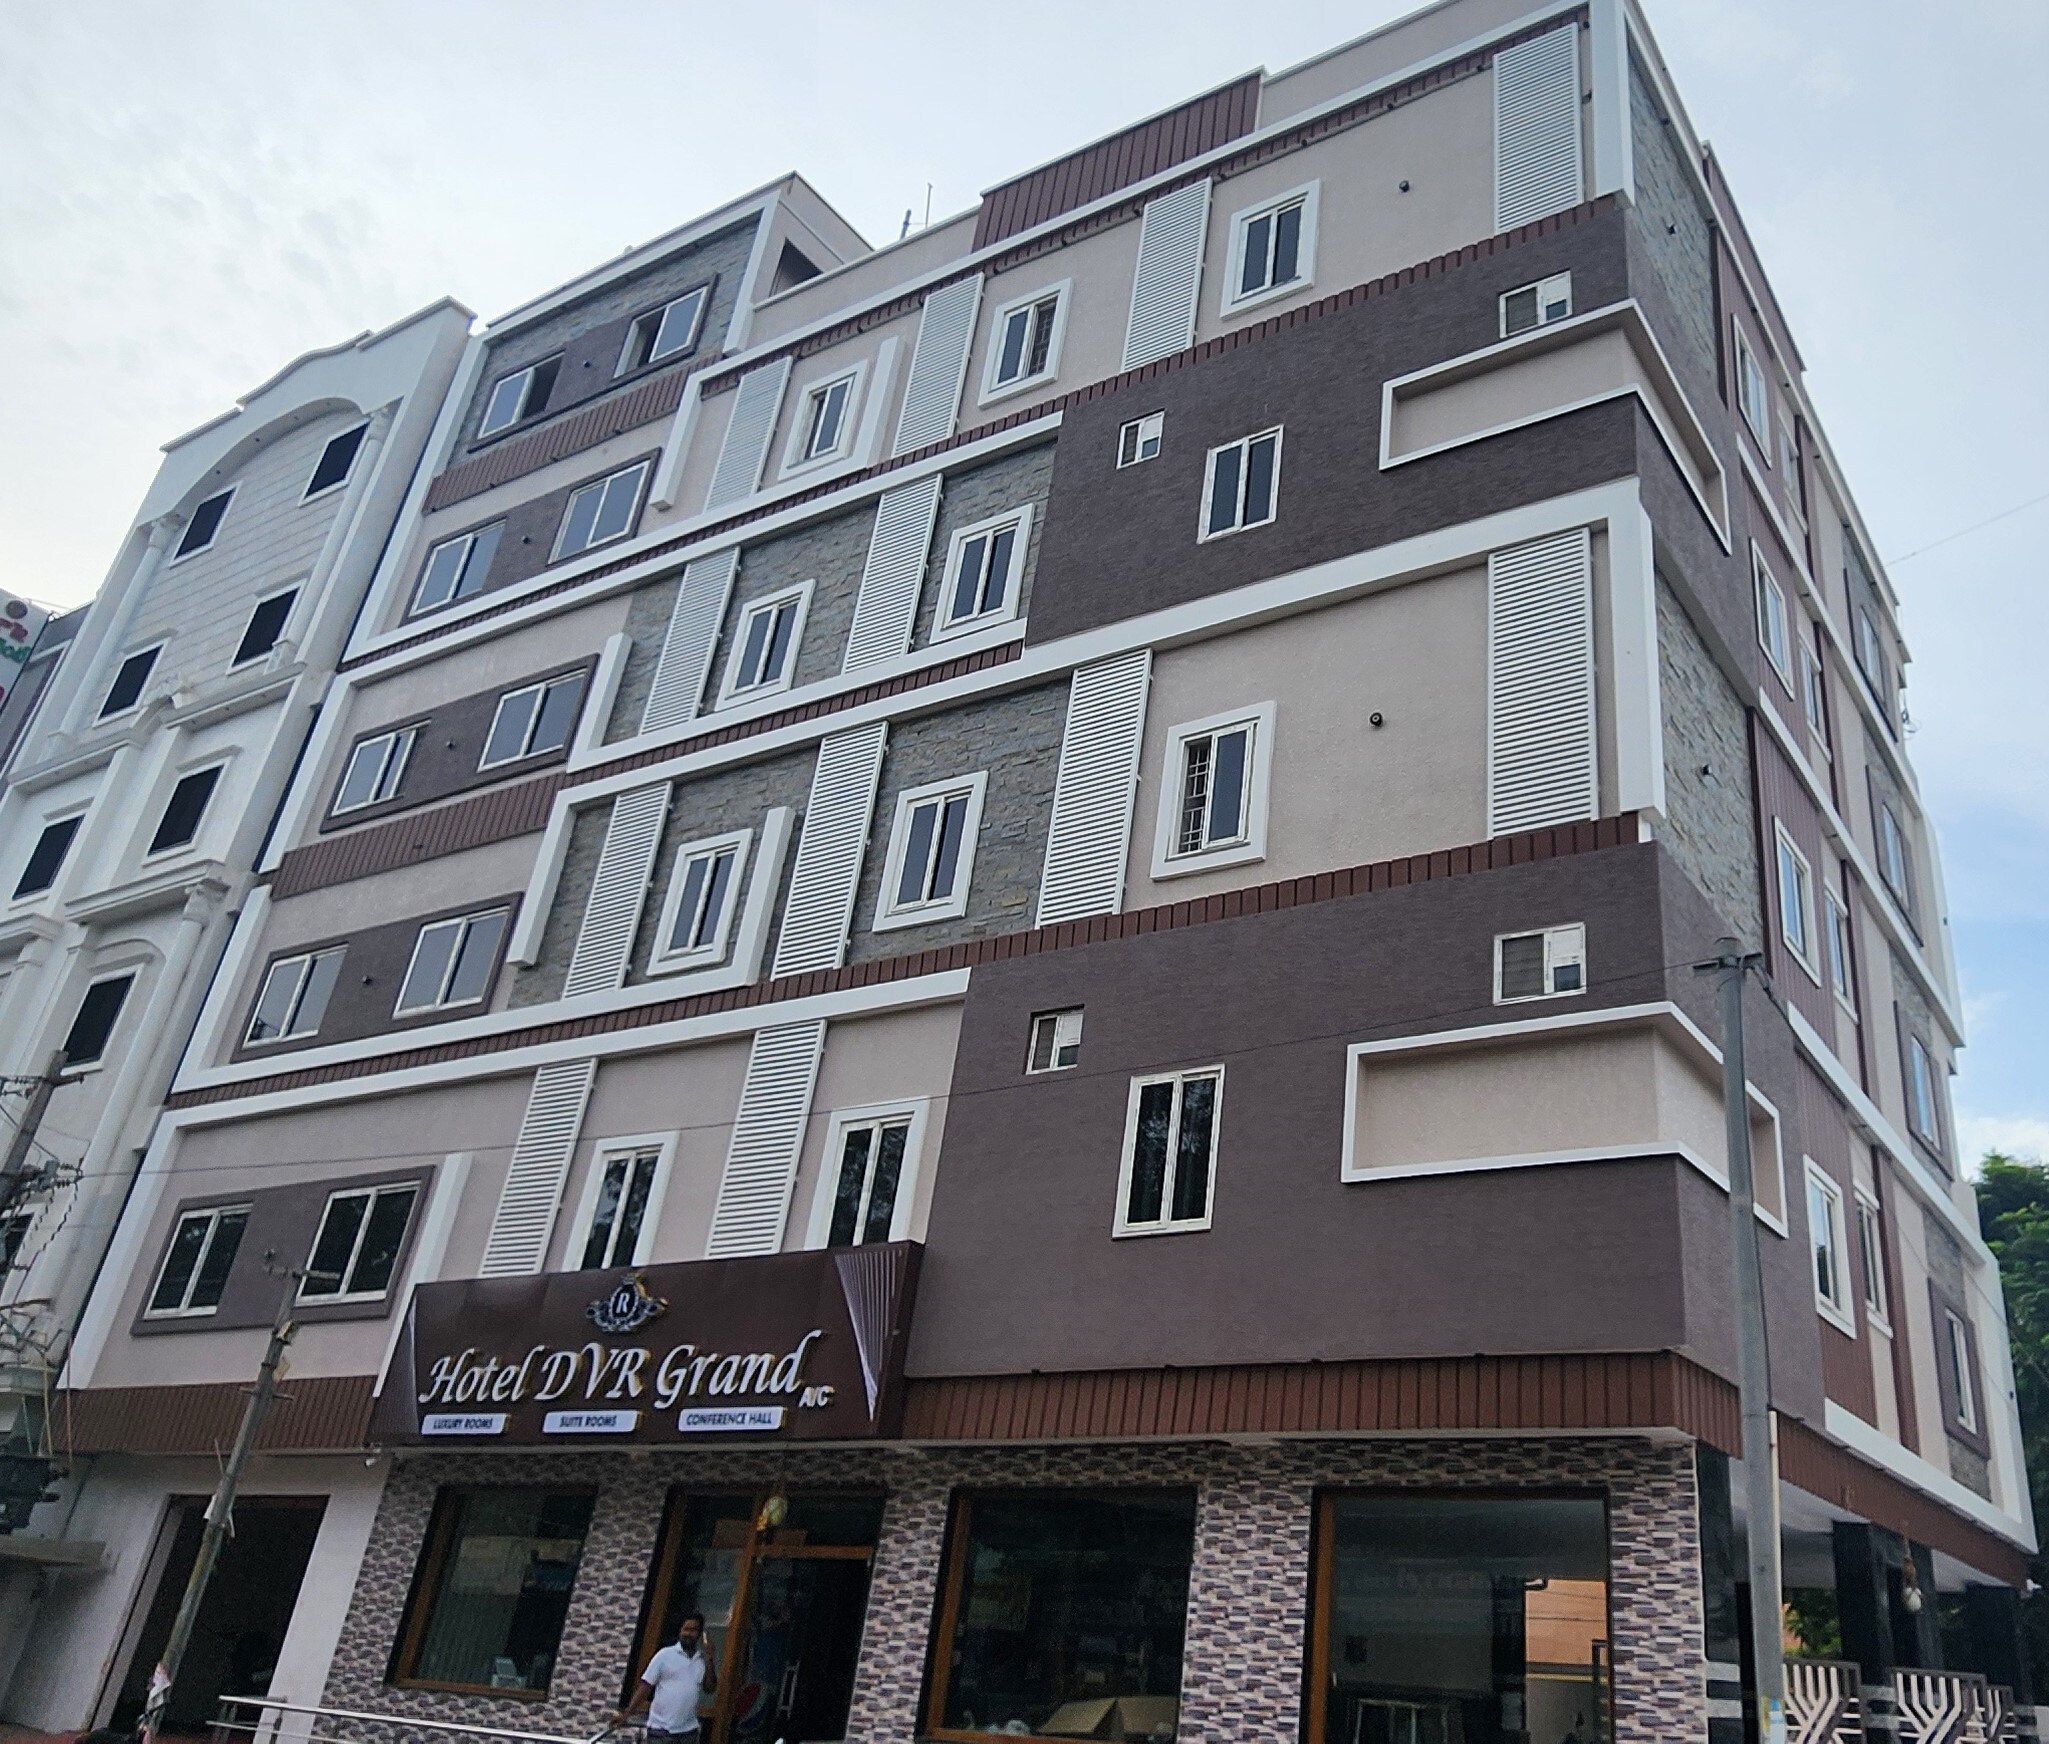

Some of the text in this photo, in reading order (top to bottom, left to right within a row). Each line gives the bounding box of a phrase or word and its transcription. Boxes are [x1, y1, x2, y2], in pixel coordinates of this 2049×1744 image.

[616, 1292, 630, 1313] R
[418, 1329, 822, 1409] Hotel DVR Grand
[433, 1417, 494, 1429] LUXURY ROOMS
[559, 1415, 617, 1427] SUITE ROOMS
[686, 1412, 772, 1426] CONFERENCE HALL
